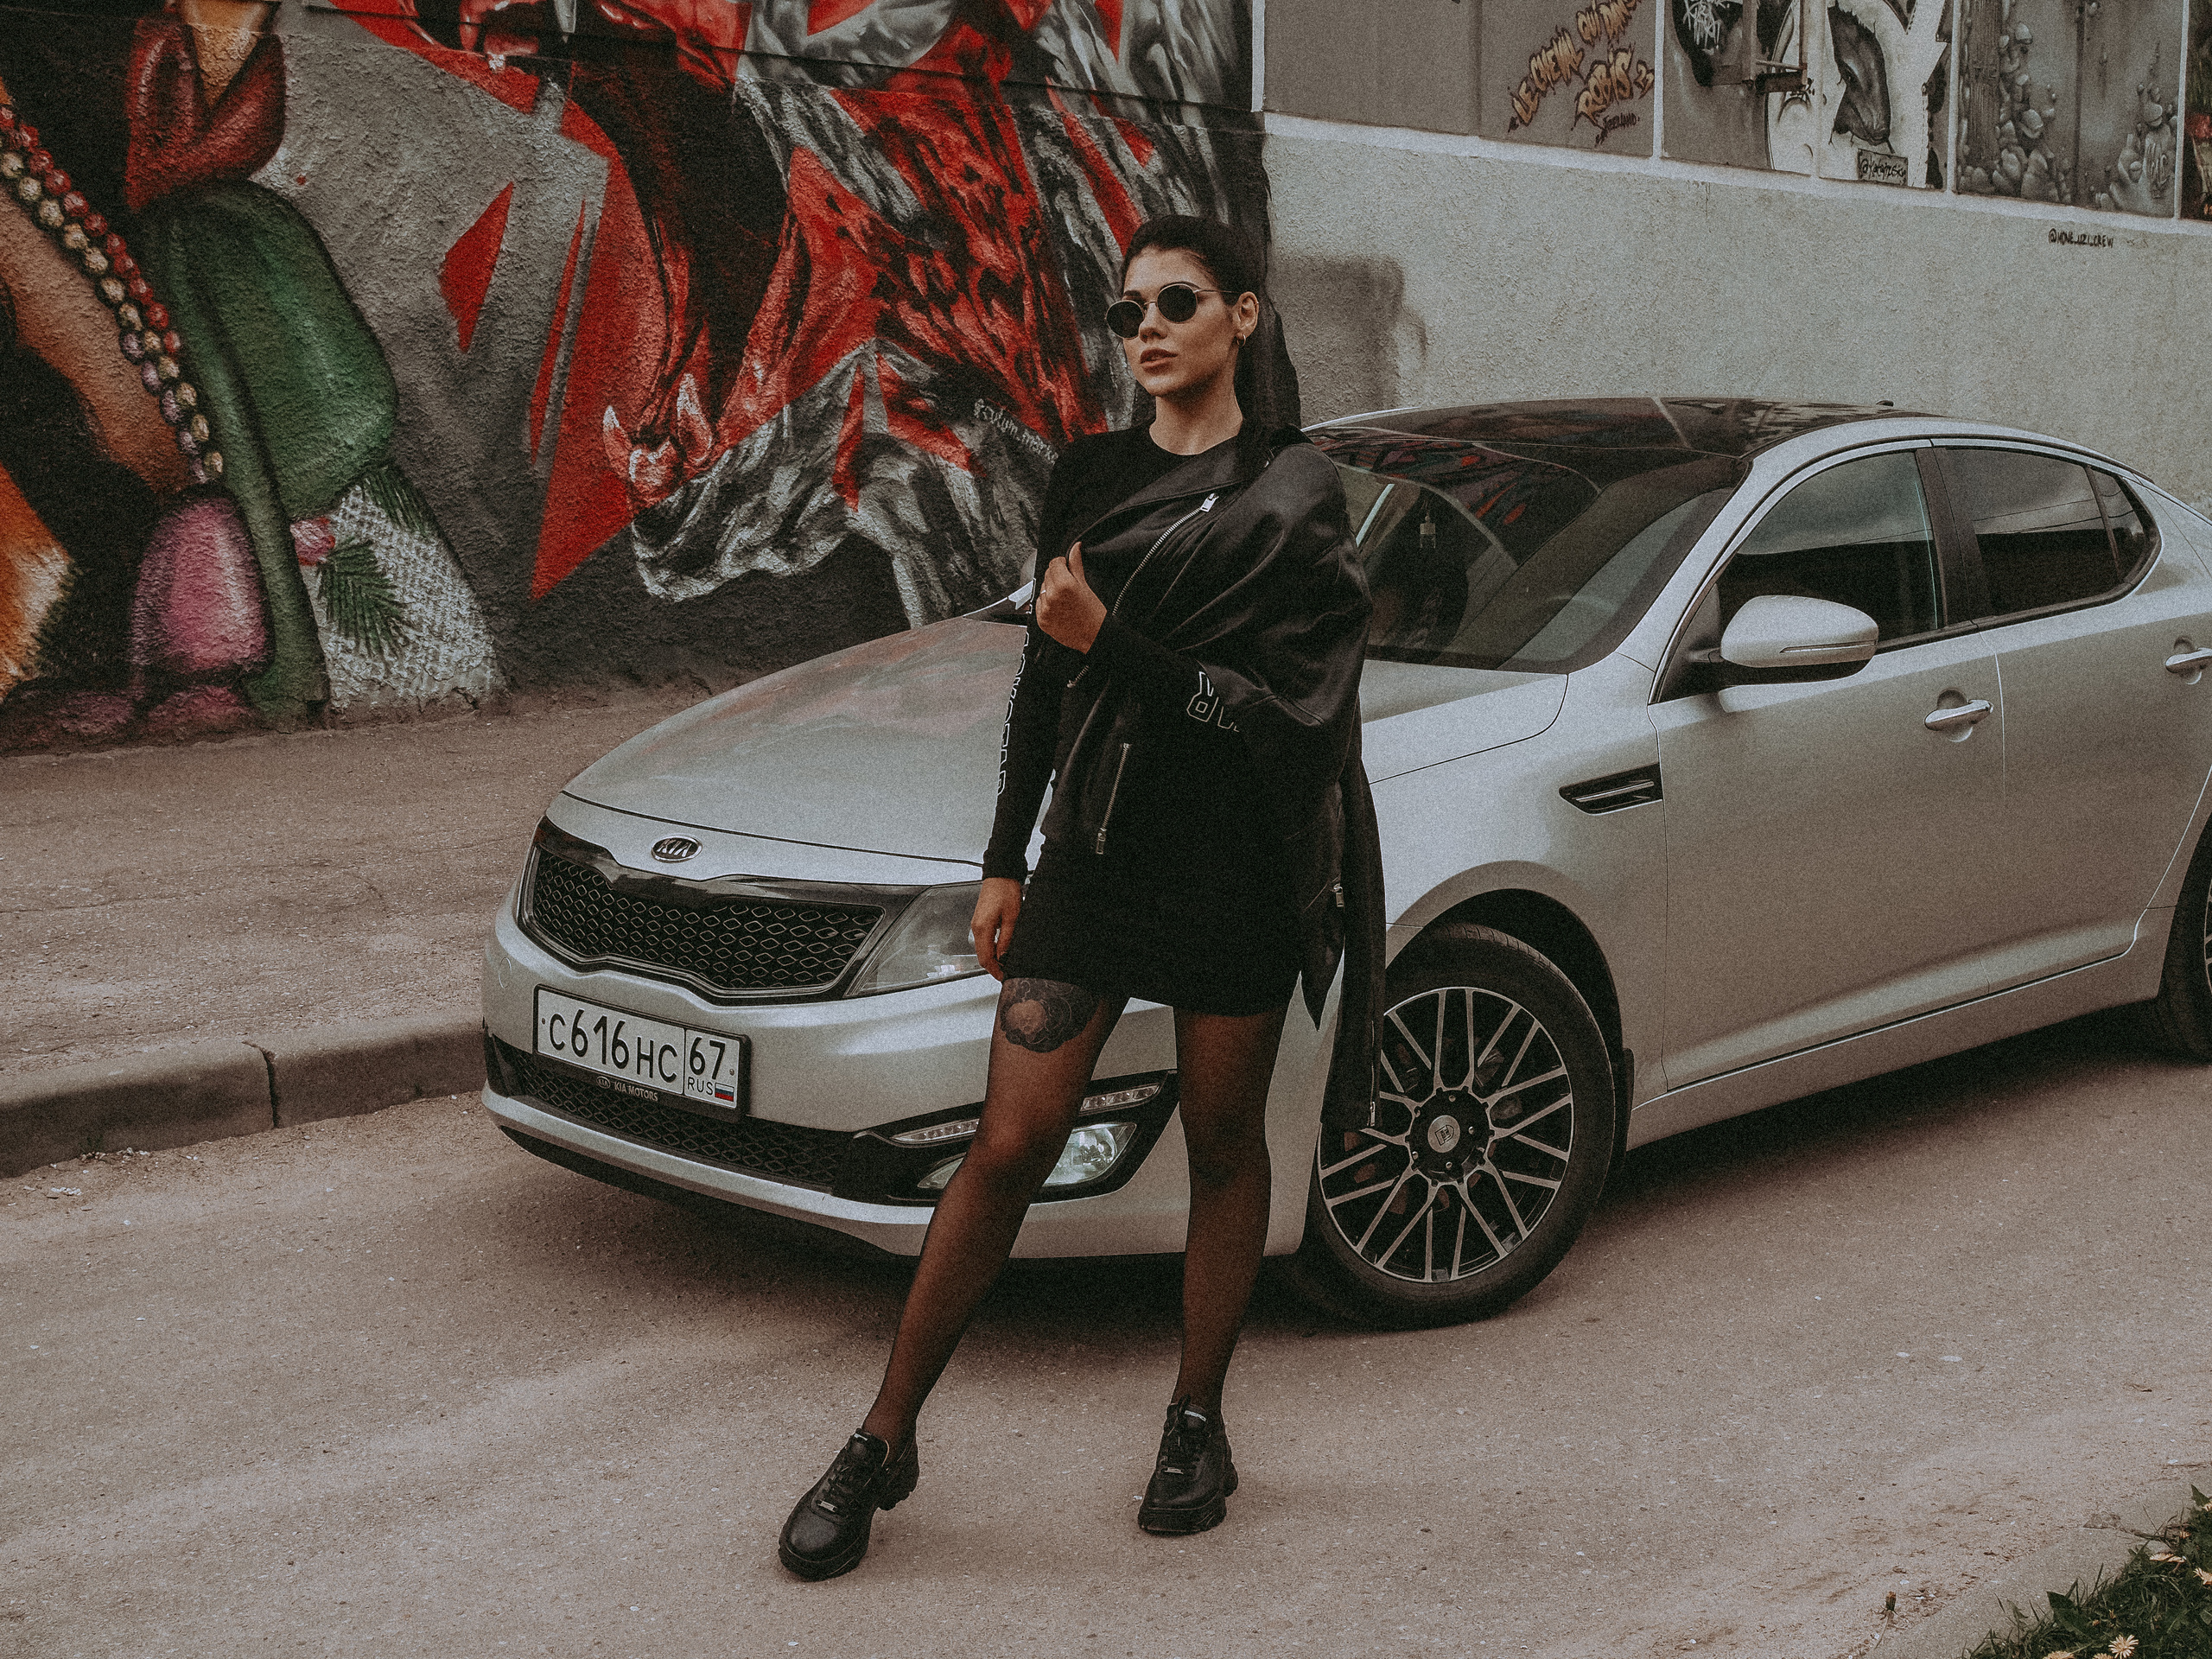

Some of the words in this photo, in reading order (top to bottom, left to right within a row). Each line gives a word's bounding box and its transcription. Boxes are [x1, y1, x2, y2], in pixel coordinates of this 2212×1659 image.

[656, 839, 693, 857] KIA
[689, 1037, 726, 1080] 67
[614, 1082, 627, 1093] KIA
[628, 1085, 658, 1102] MOTORS
[687, 1077, 714, 1096] RUS
